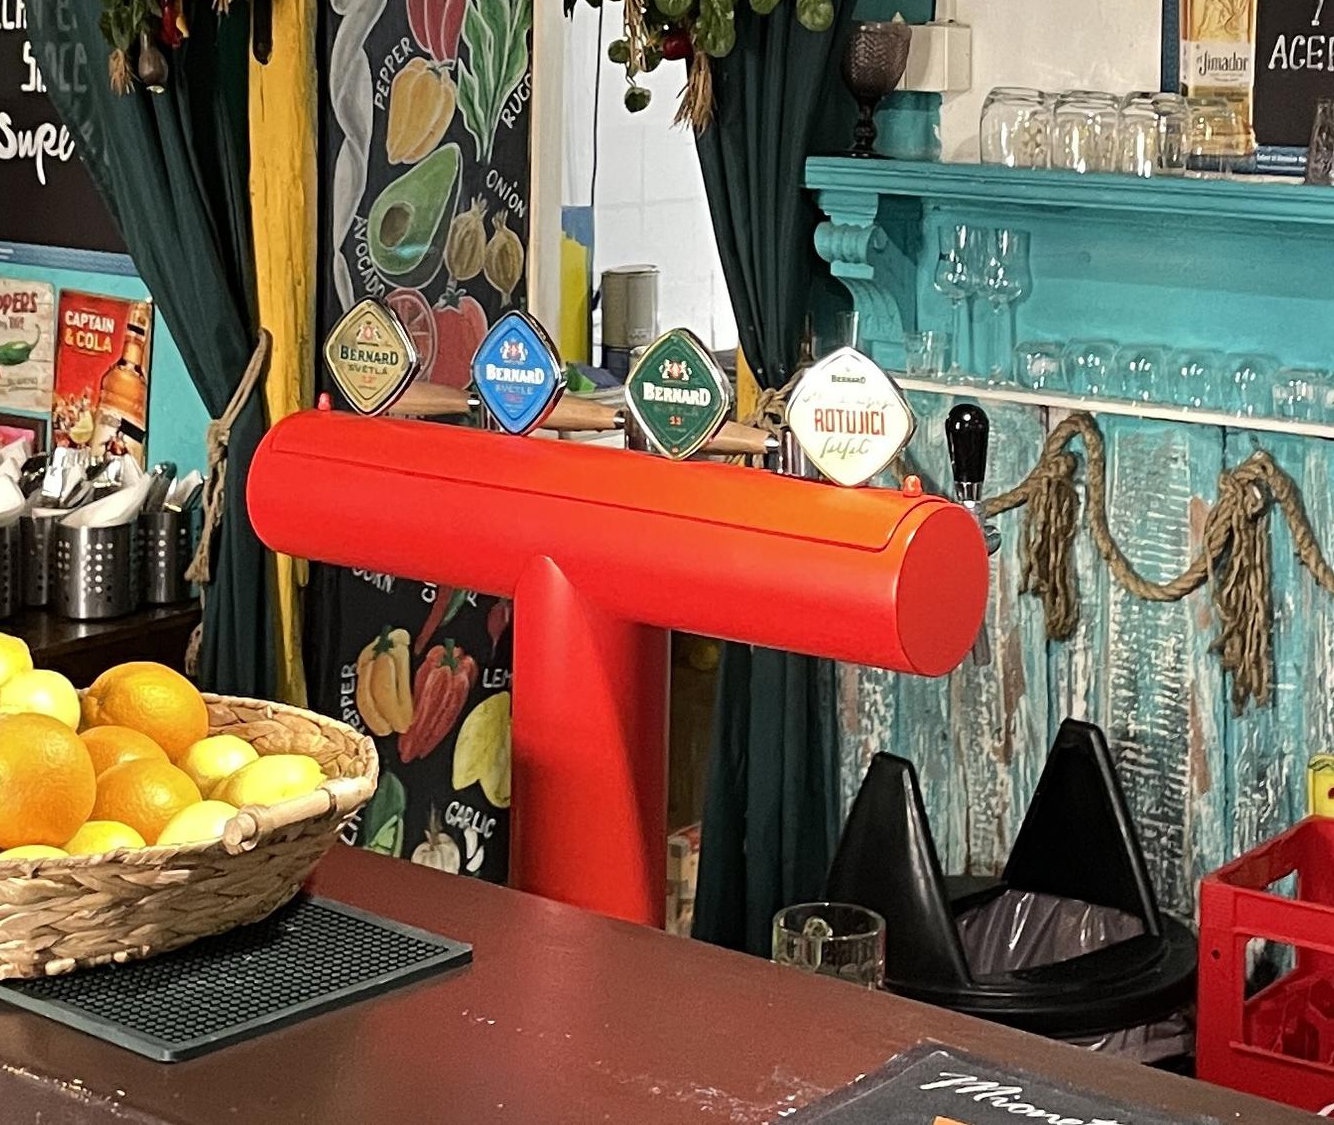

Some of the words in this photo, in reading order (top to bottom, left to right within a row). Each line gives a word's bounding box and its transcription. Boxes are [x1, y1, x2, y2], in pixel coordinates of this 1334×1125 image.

[374, 36, 414, 110] PEPPER
[1199, 51, 1249, 76] Jimador
[65, 310, 114, 334] CAPTAIN
[64, 330, 74, 346] &
[76, 331, 113, 353] COLA
[340, 344, 399, 366] BERNARD
[485, 363, 545, 385] BERNARD
[643, 381, 711, 407] BERNARD
[445, 800, 497, 839] GARLIC
